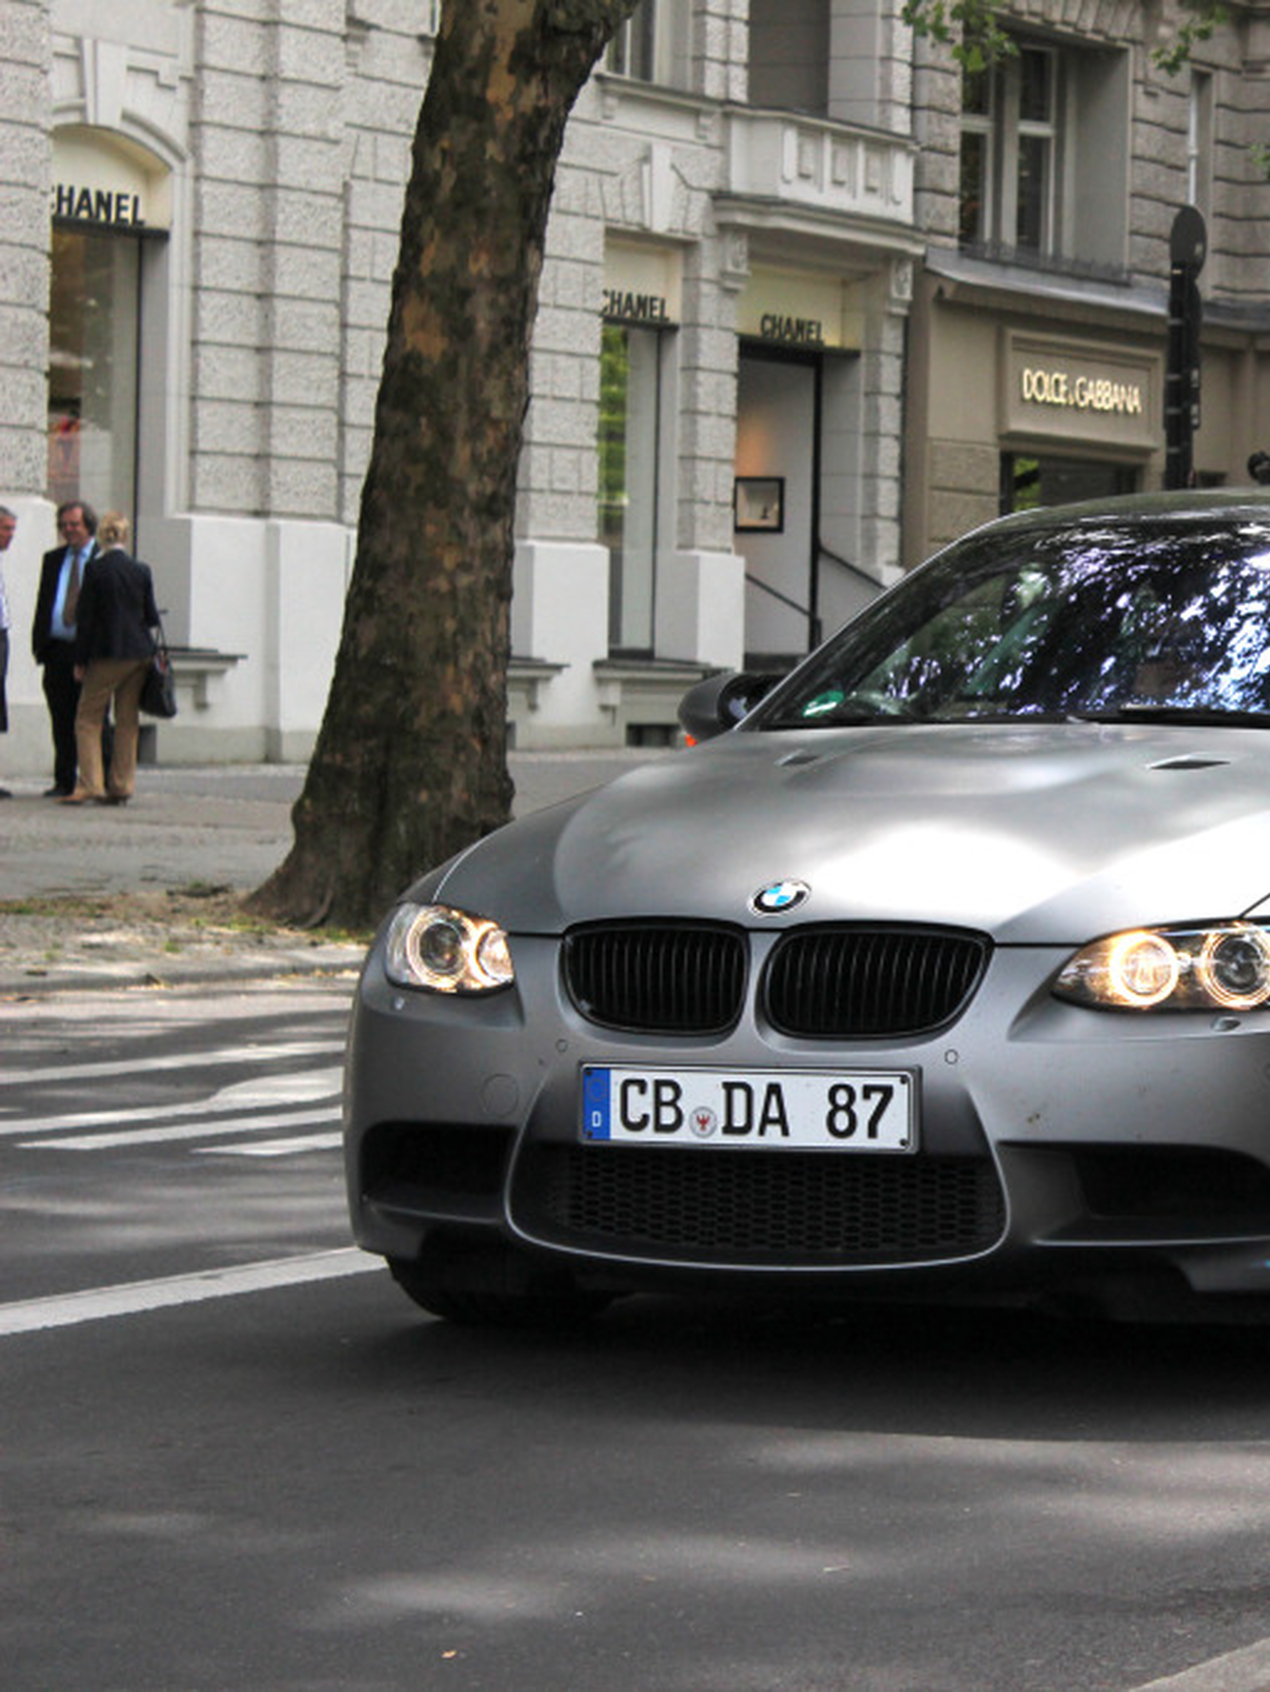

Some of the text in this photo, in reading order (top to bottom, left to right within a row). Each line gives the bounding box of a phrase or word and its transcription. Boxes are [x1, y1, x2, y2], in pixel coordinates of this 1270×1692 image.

[51, 183, 144, 226] HANEL
[760, 313, 824, 345] CHANEL
[1023, 368, 1067, 403] DOLCE
[1075, 376, 1142, 413] GABBANA
[619, 1078, 894, 1140] CB DA 87
